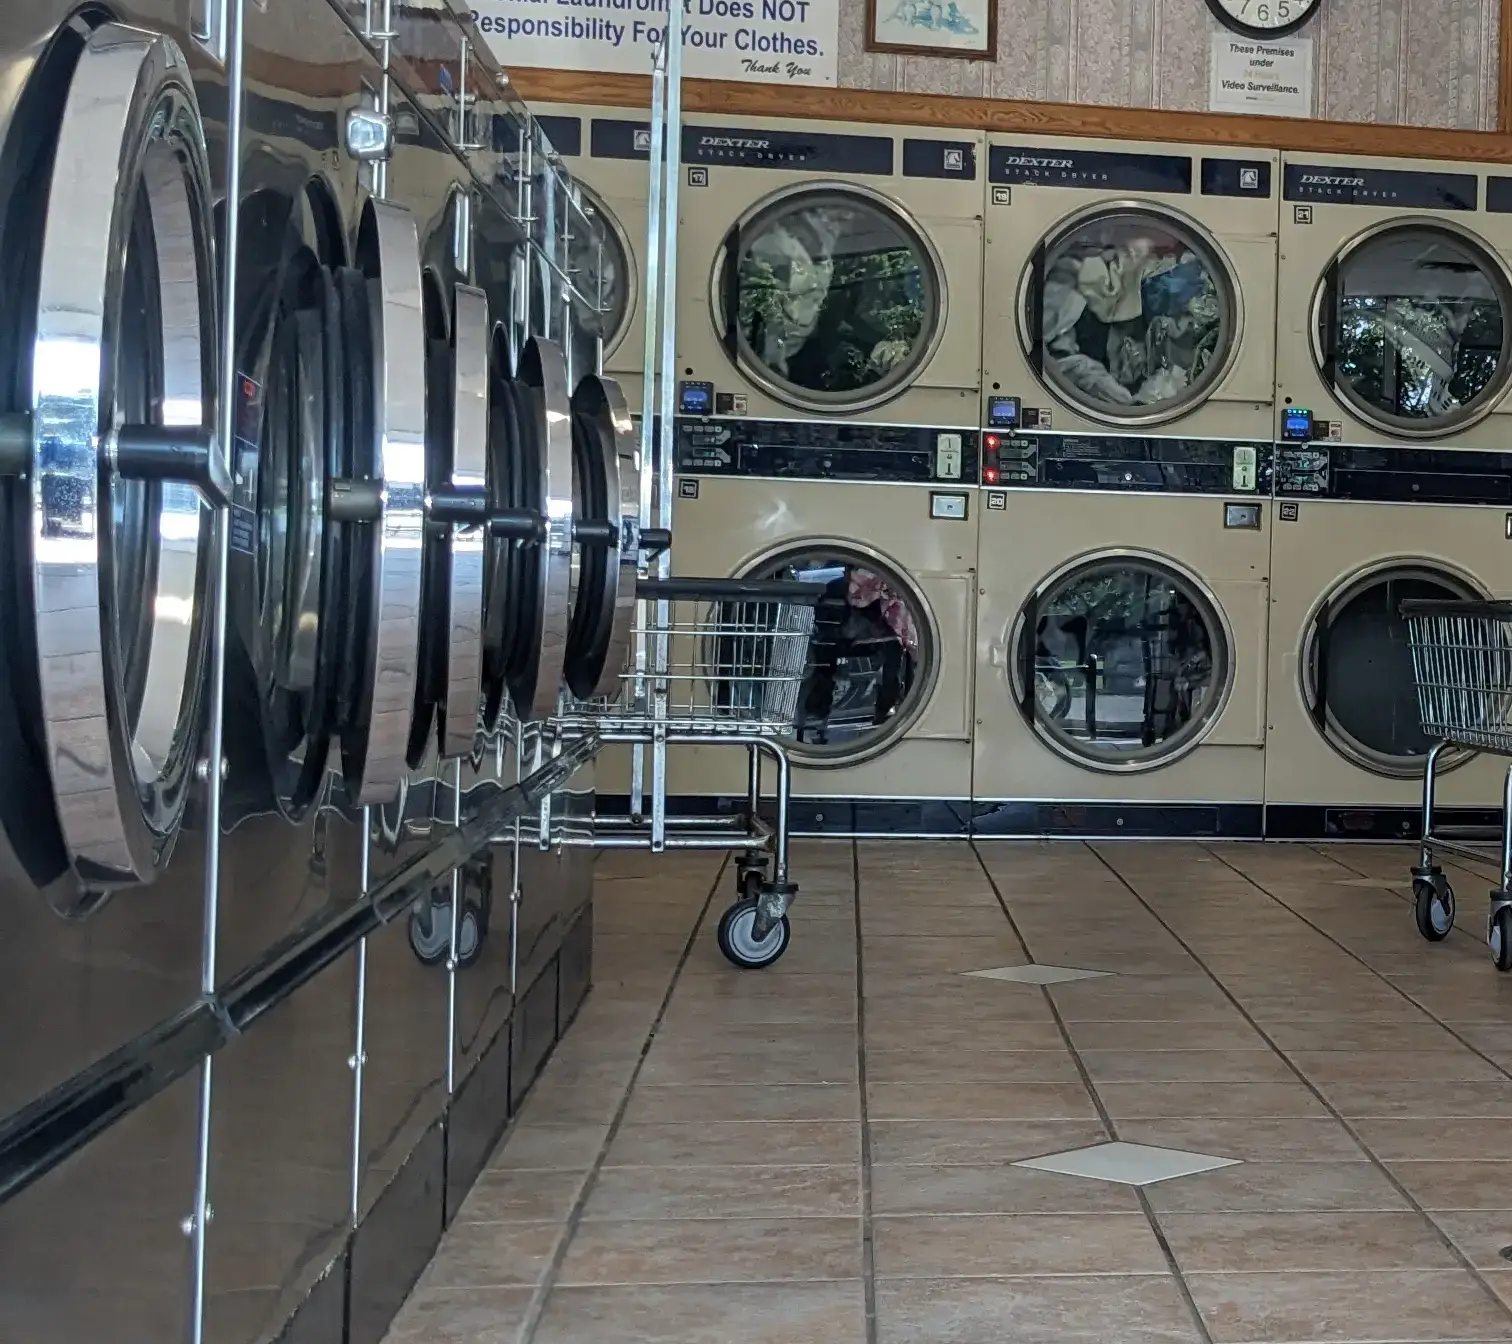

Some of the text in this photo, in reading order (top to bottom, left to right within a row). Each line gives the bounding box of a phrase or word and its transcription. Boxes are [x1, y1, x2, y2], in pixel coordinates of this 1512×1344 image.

[1257, 4, 1269, 21] 6
[1278, 0, 1290, 17] 5
[681, 24, 728, 50] Your
[734, 28, 824, 57] Clothes.
[1230, 43, 1295, 57] These Premises
[741, 59, 812, 78] Thank You
[1249, 58, 1274, 67] under
[1221, 79, 1246, 90] Video
[700, 136, 770, 149] DEXTER
[1006, 156, 1074, 168] DEXTER
[1300, 174, 1365, 186] DEXTER
